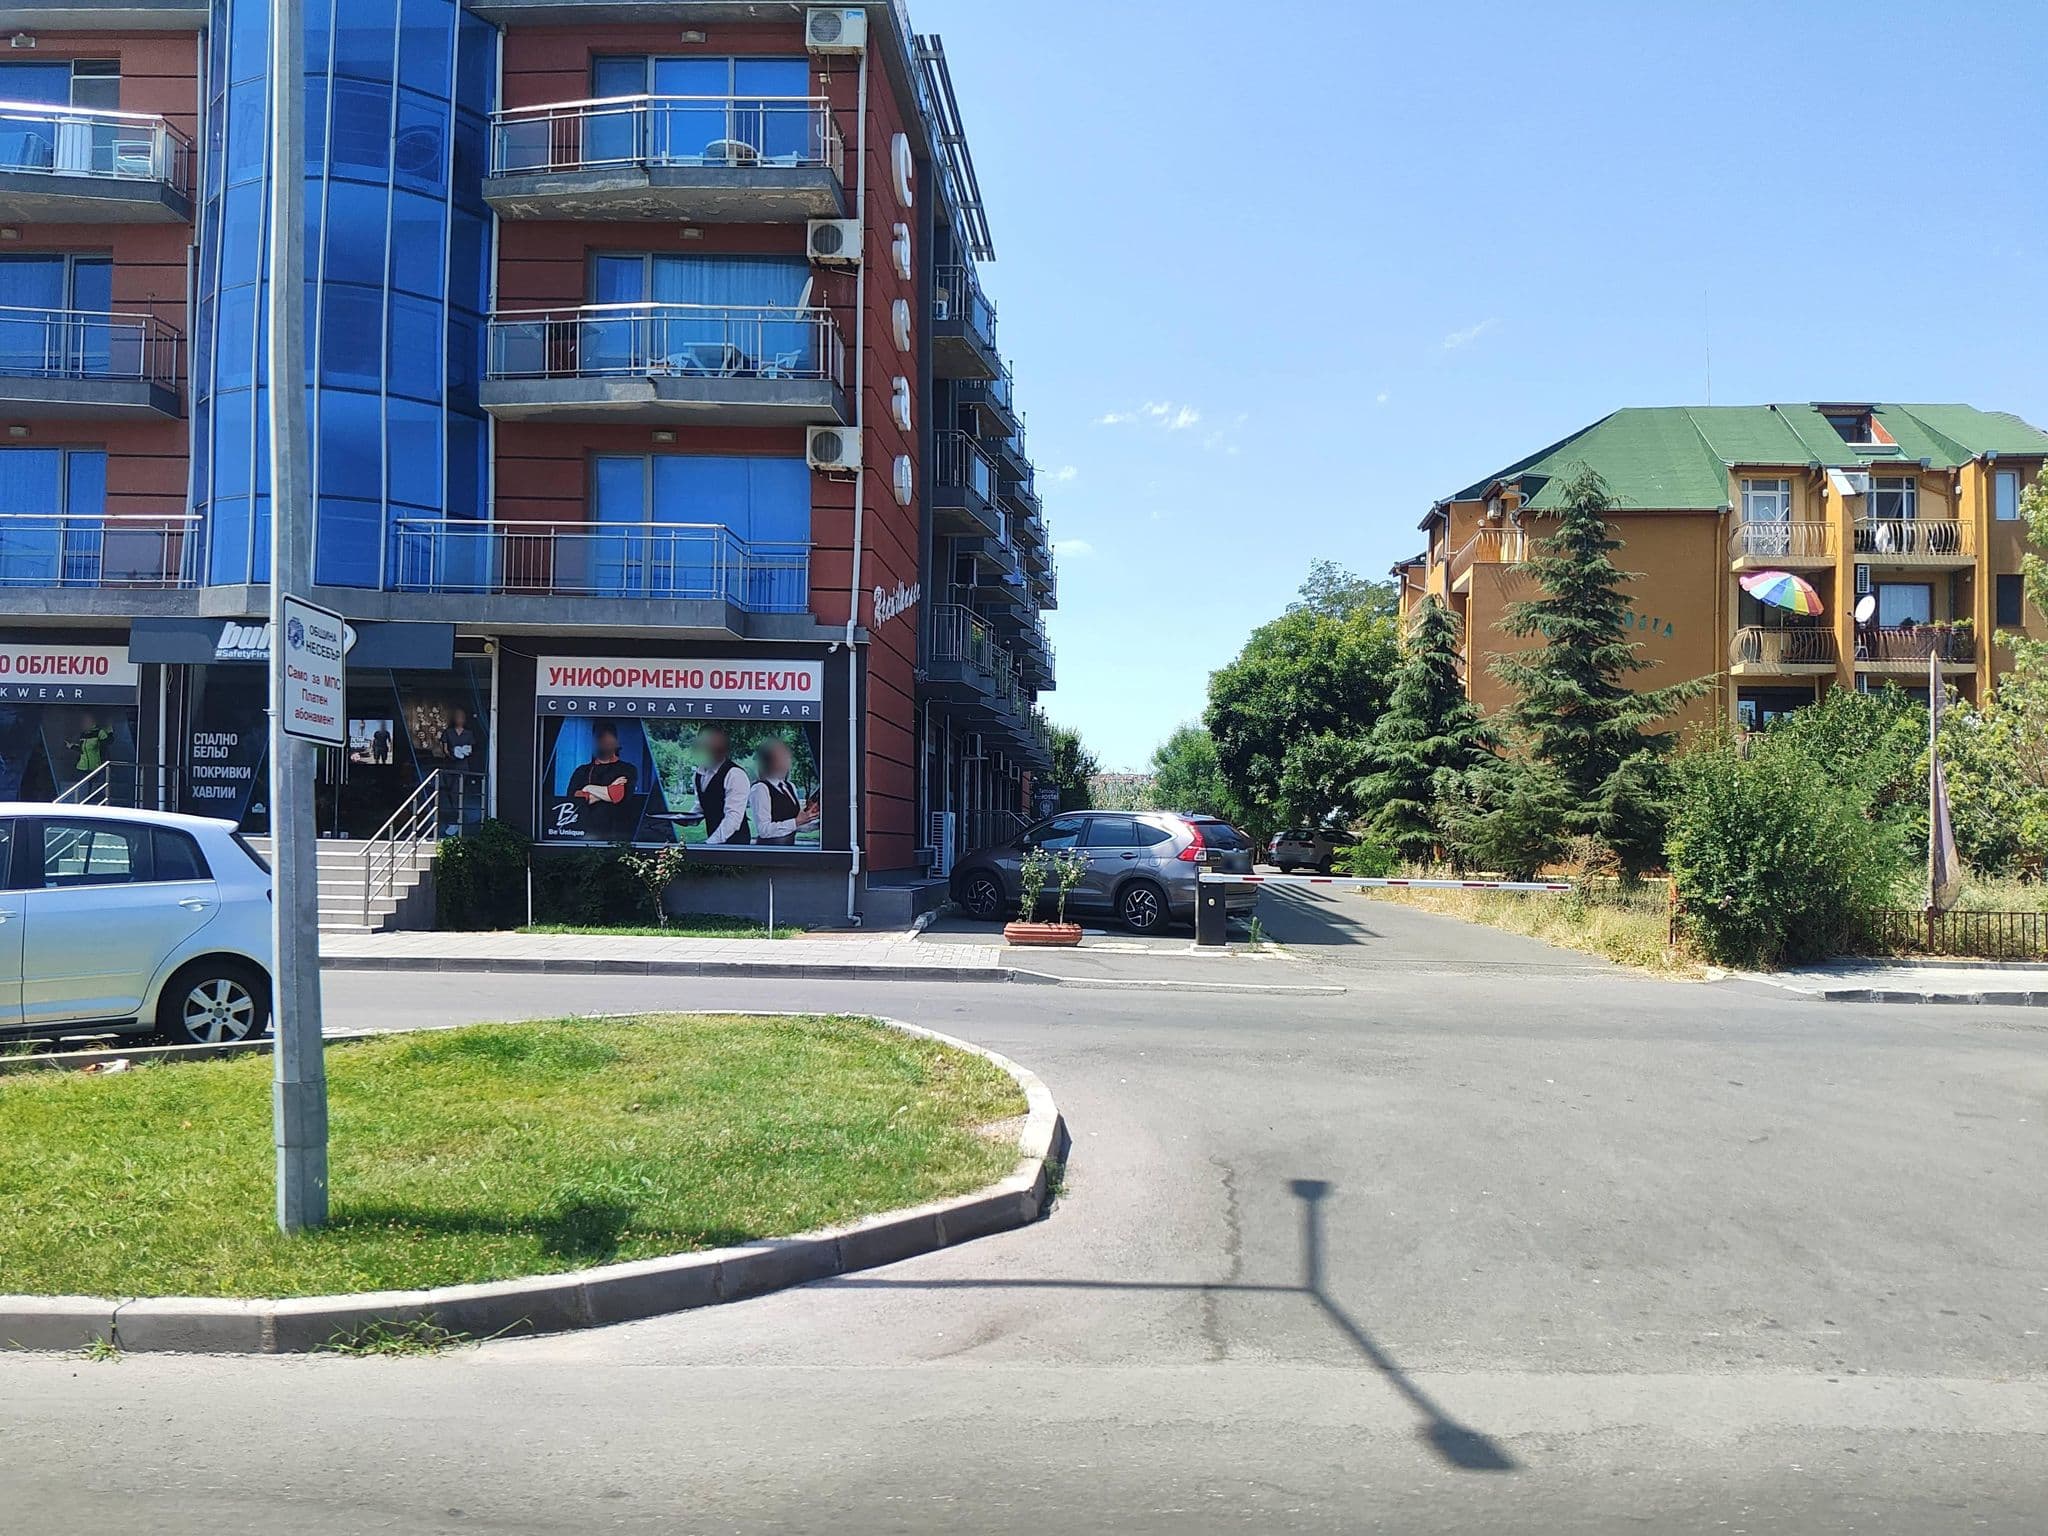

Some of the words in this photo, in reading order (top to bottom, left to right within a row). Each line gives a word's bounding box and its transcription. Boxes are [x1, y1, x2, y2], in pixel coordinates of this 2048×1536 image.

[308, 624, 338, 643] ОБЩИНА
[214, 649, 271, 659] #SafetyFirs
[305, 640, 341, 661] НЕСЕБЪР
[15, 655, 109, 676] ОБЛЕКЛО
[287, 663, 308, 682] Само
[311, 673, 321, 686] за
[323, 674, 342, 691] МПС
[549, 666, 704, 689] УНИФОРМЕНО
[709, 670, 812, 691] ОБЛЕКЛО
[301, 687, 329, 706] Платен
[294, 706, 336, 727] абонамент
[547, 700, 714, 714] CORPORATE
[738, 703, 811, 716] WEAR
[193, 732, 238, 746] СПАЛНО
[193, 745, 229, 759] БЕЛЬО
[192, 765, 251, 779] ПОКРИВКИ
[191, 785, 236, 799] ХАВЛИИ
[548, 828, 558, 836] Be
[559, 828, 585, 837] Unique
